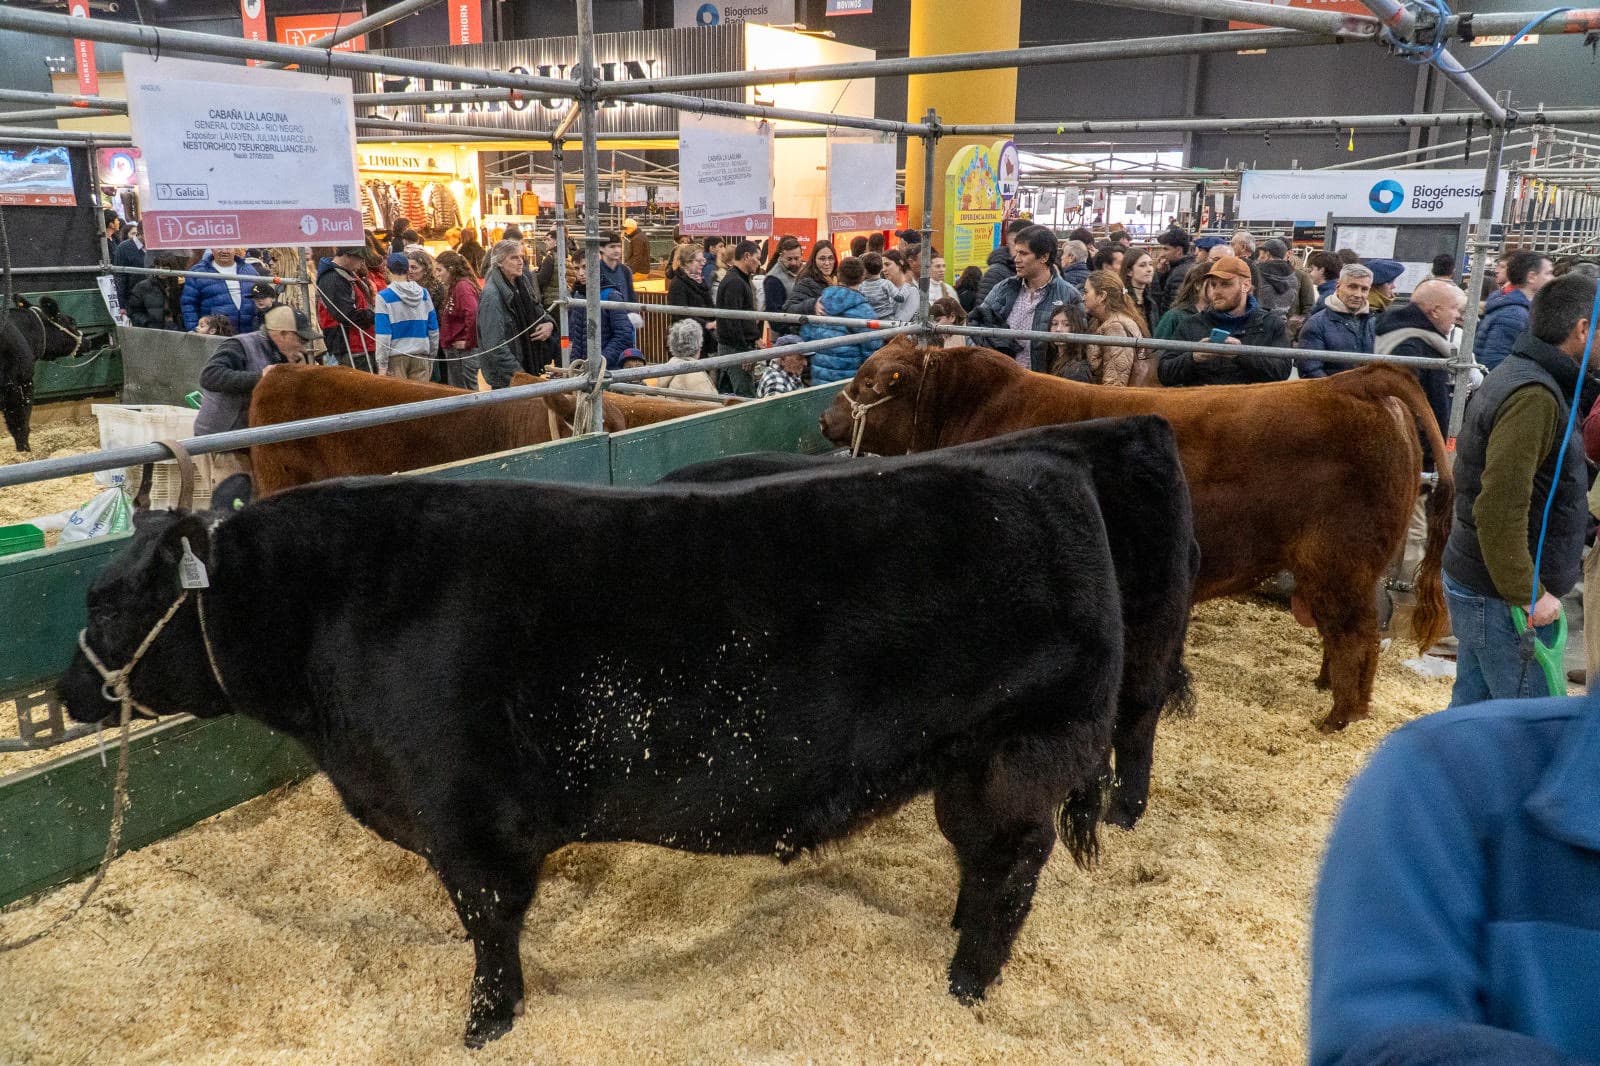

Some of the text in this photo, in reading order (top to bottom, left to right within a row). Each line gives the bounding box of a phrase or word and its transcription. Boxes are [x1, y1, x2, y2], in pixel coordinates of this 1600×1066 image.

[724, 5, 768, 17] Biogénesis
[209, 108, 288, 122] CABAÑA LA LAGUNA
[194, 120, 229, 130] GENERAL
[231, 121, 260, 131] CONESA
[279, 124, 304, 133] NEGRO
[256, 133, 280, 143] JULIAN
[281, 134, 314, 144] MARCELO
[183, 141, 236, 151] NESTORCHICO
[368, 154, 421, 168] LIMOUSIN
[175, 186, 205, 198] Galicia
[1413, 184, 1481, 200] Biogénesis
[1411, 198, 1444, 212] Bagó
[186, 220, 234, 236] Galicia
[322, 216, 353, 232] Rural
[754, 220, 768, 230] Rural
